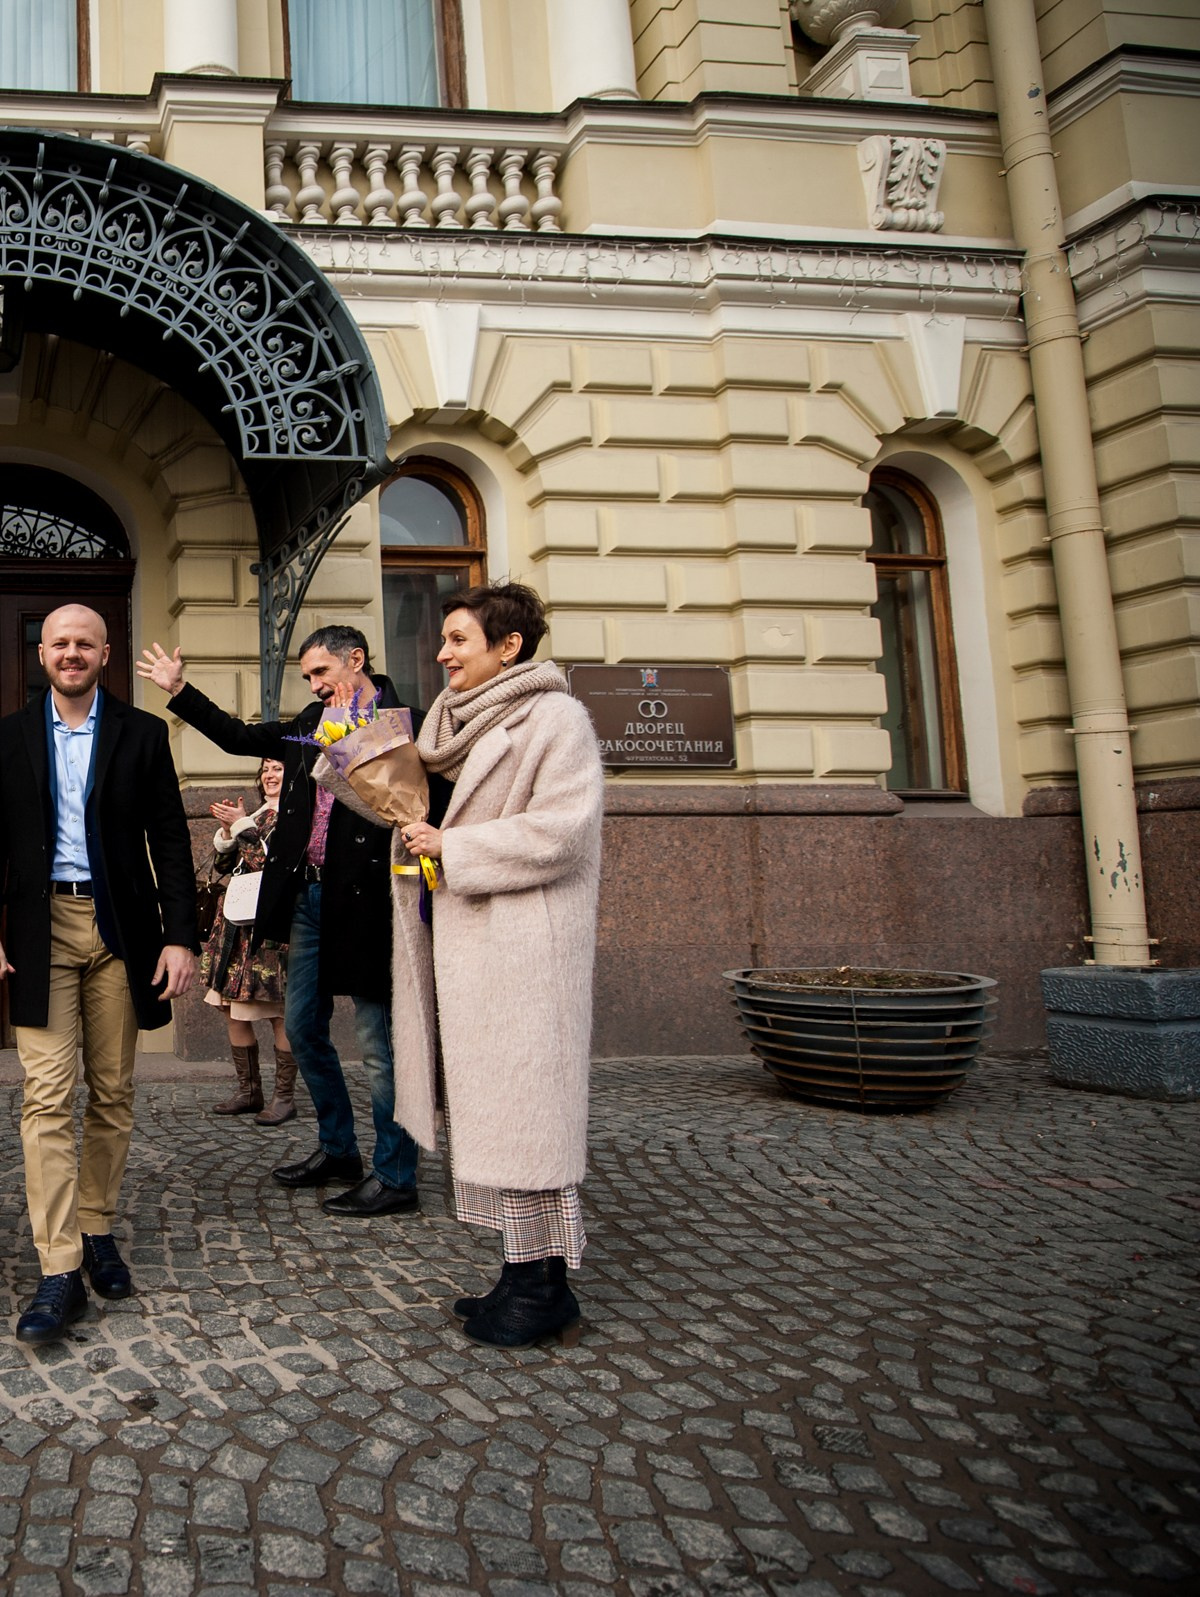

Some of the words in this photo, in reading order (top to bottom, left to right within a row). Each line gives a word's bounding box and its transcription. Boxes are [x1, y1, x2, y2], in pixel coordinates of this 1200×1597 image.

[624, 722, 685, 735] ДВОРЕЦ
[598, 740, 724, 752] РАКОСОЧЕТАНИЯ
[678, 754, 688, 762] 52
